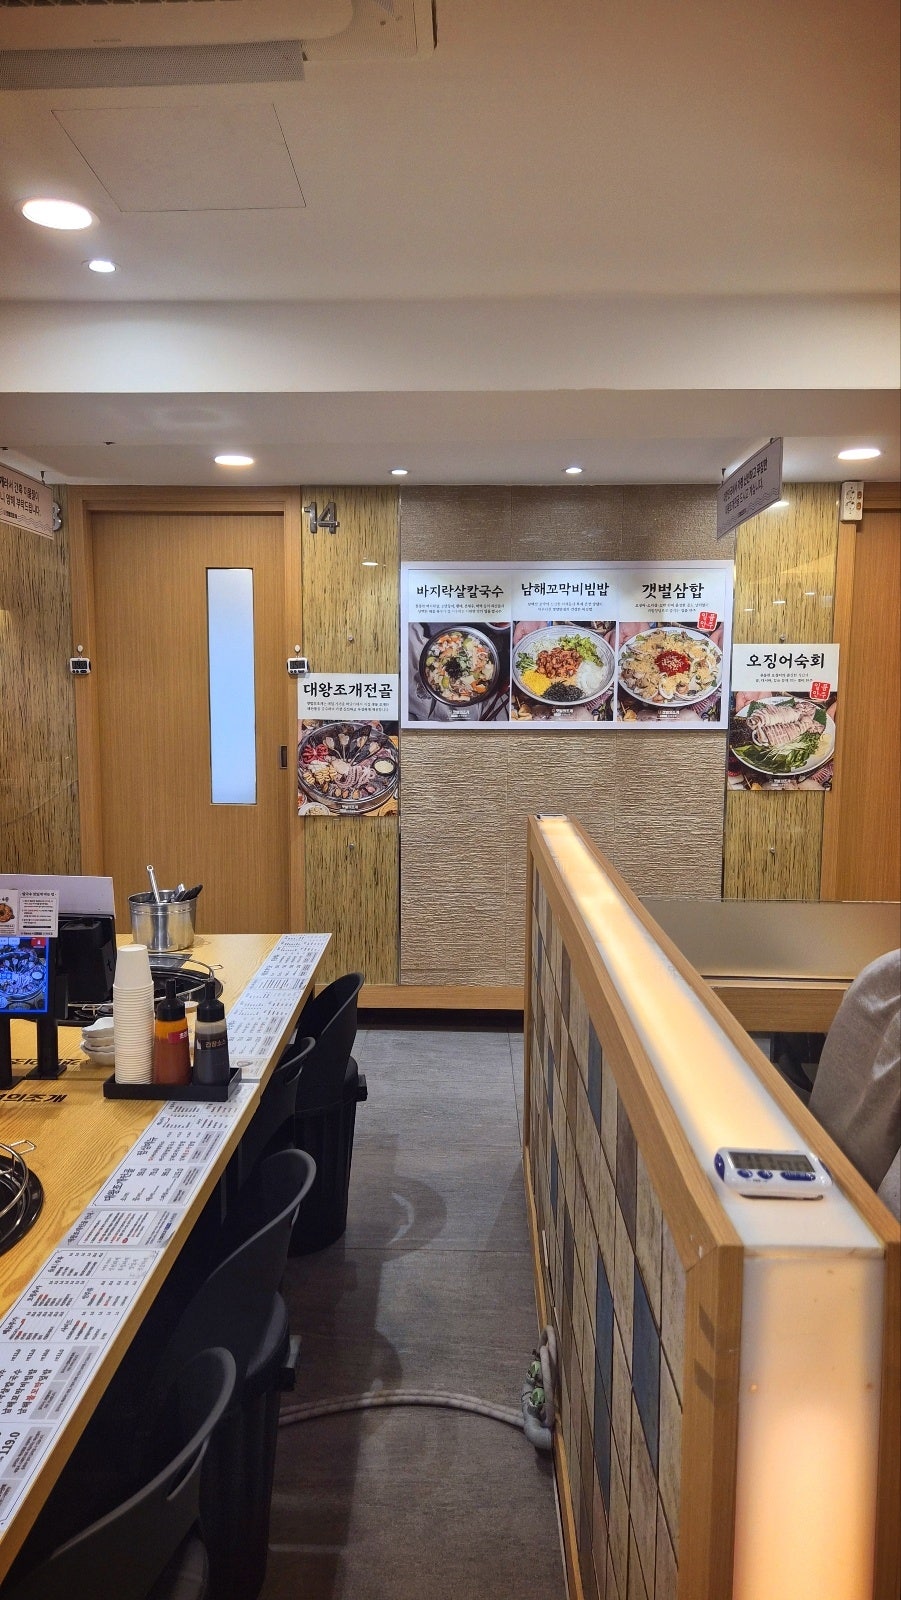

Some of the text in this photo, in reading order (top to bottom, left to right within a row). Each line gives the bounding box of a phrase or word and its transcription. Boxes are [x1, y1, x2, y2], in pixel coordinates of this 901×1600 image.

[303, 501, 341, 535] 14
[416, 584, 504, 599] 바지락살칼국수
[521, 582, 610, 596] 남해꼬막비빔밥
[642, 582, 704, 599] 갯벌삼합
[746, 652, 825, 669] 오징어숙회
[303, 681, 393, 699] 대왕조개전골
[0, 1093, 68, 1103] 의조개
[1, 1368, 38, 1415] 남해꼬막비빔밥
[17, 1368, 53, 1415] 남해불꼬막덮밥
[2, 1431, 21, 1457] 119.0
